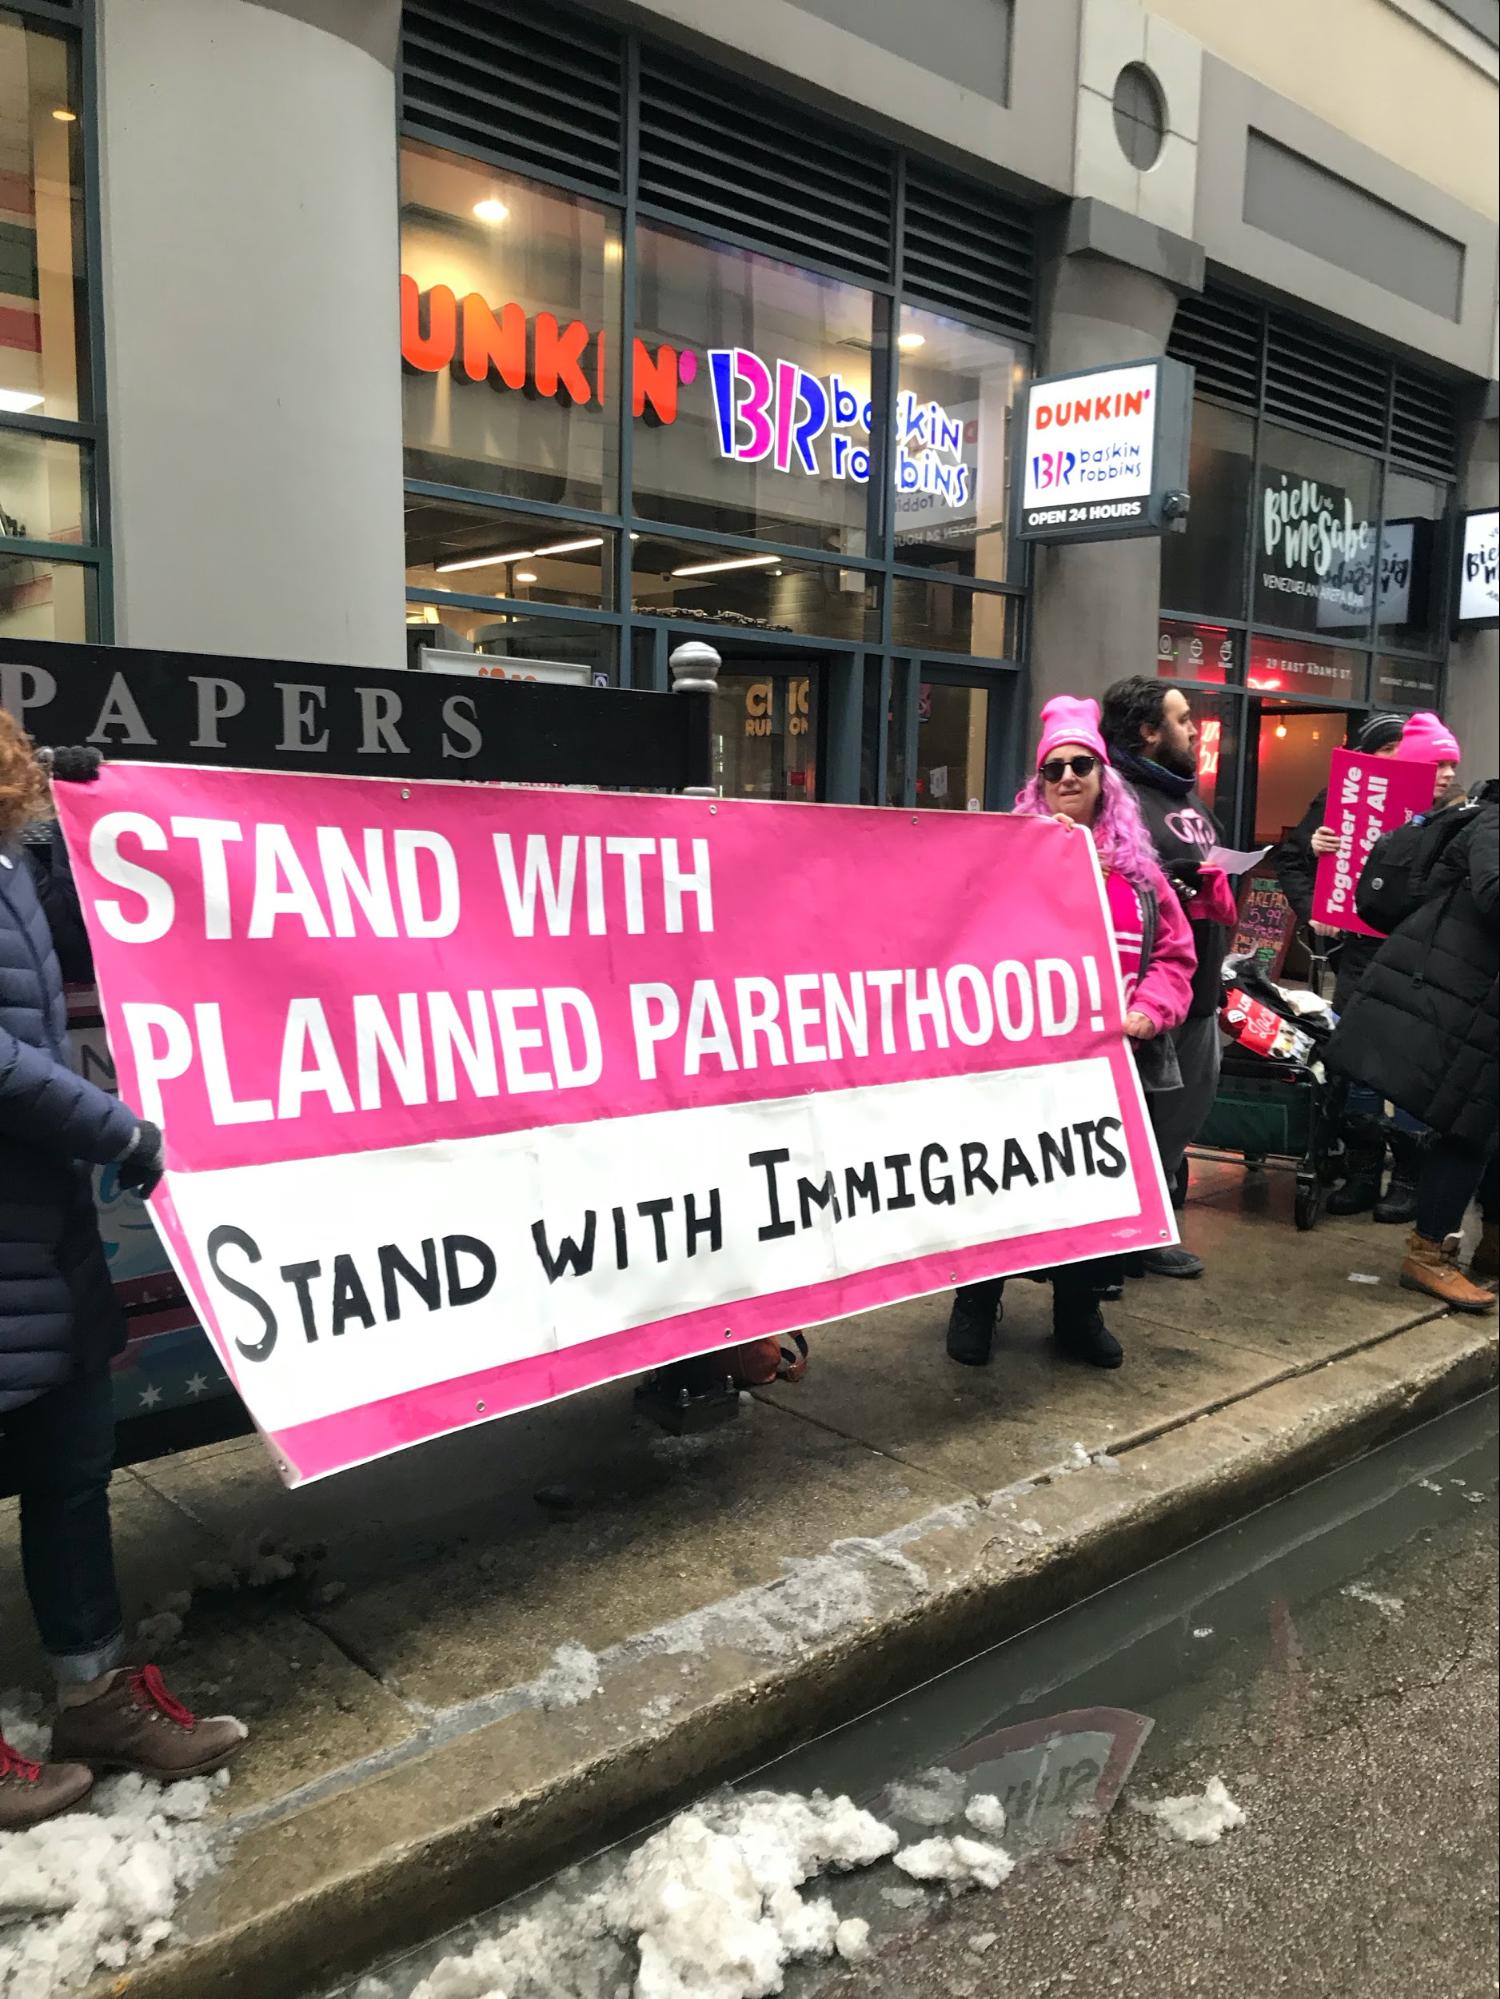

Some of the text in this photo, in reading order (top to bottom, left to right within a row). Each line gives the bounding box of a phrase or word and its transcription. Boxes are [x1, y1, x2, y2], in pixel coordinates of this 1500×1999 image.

[400, 274, 697, 425] UNKN'
[1035, 388, 1151, 430] DUNKIN'
[1080, 442, 1140, 464] baskin
[1080, 461, 1142, 483] robbins
[1028, 502, 1142, 526] OPEN 24 HOURS
[1264, 474, 1321, 556] Bien
[1280, 660, 1305, 673] EAST
[1306, 664, 1338, 678] ADAMS
[0, 664, 482, 759] PAPERS
[1340, 766, 1362, 804] We
[1366, 775, 1390, 813] All
[89, 811, 714, 945] STAND WITH
[121, 956, 1105, 1131] PLANNED PARENTHOOD!
[206, 1116, 1128, 1363] STAND WITH IMMIGRANTS
